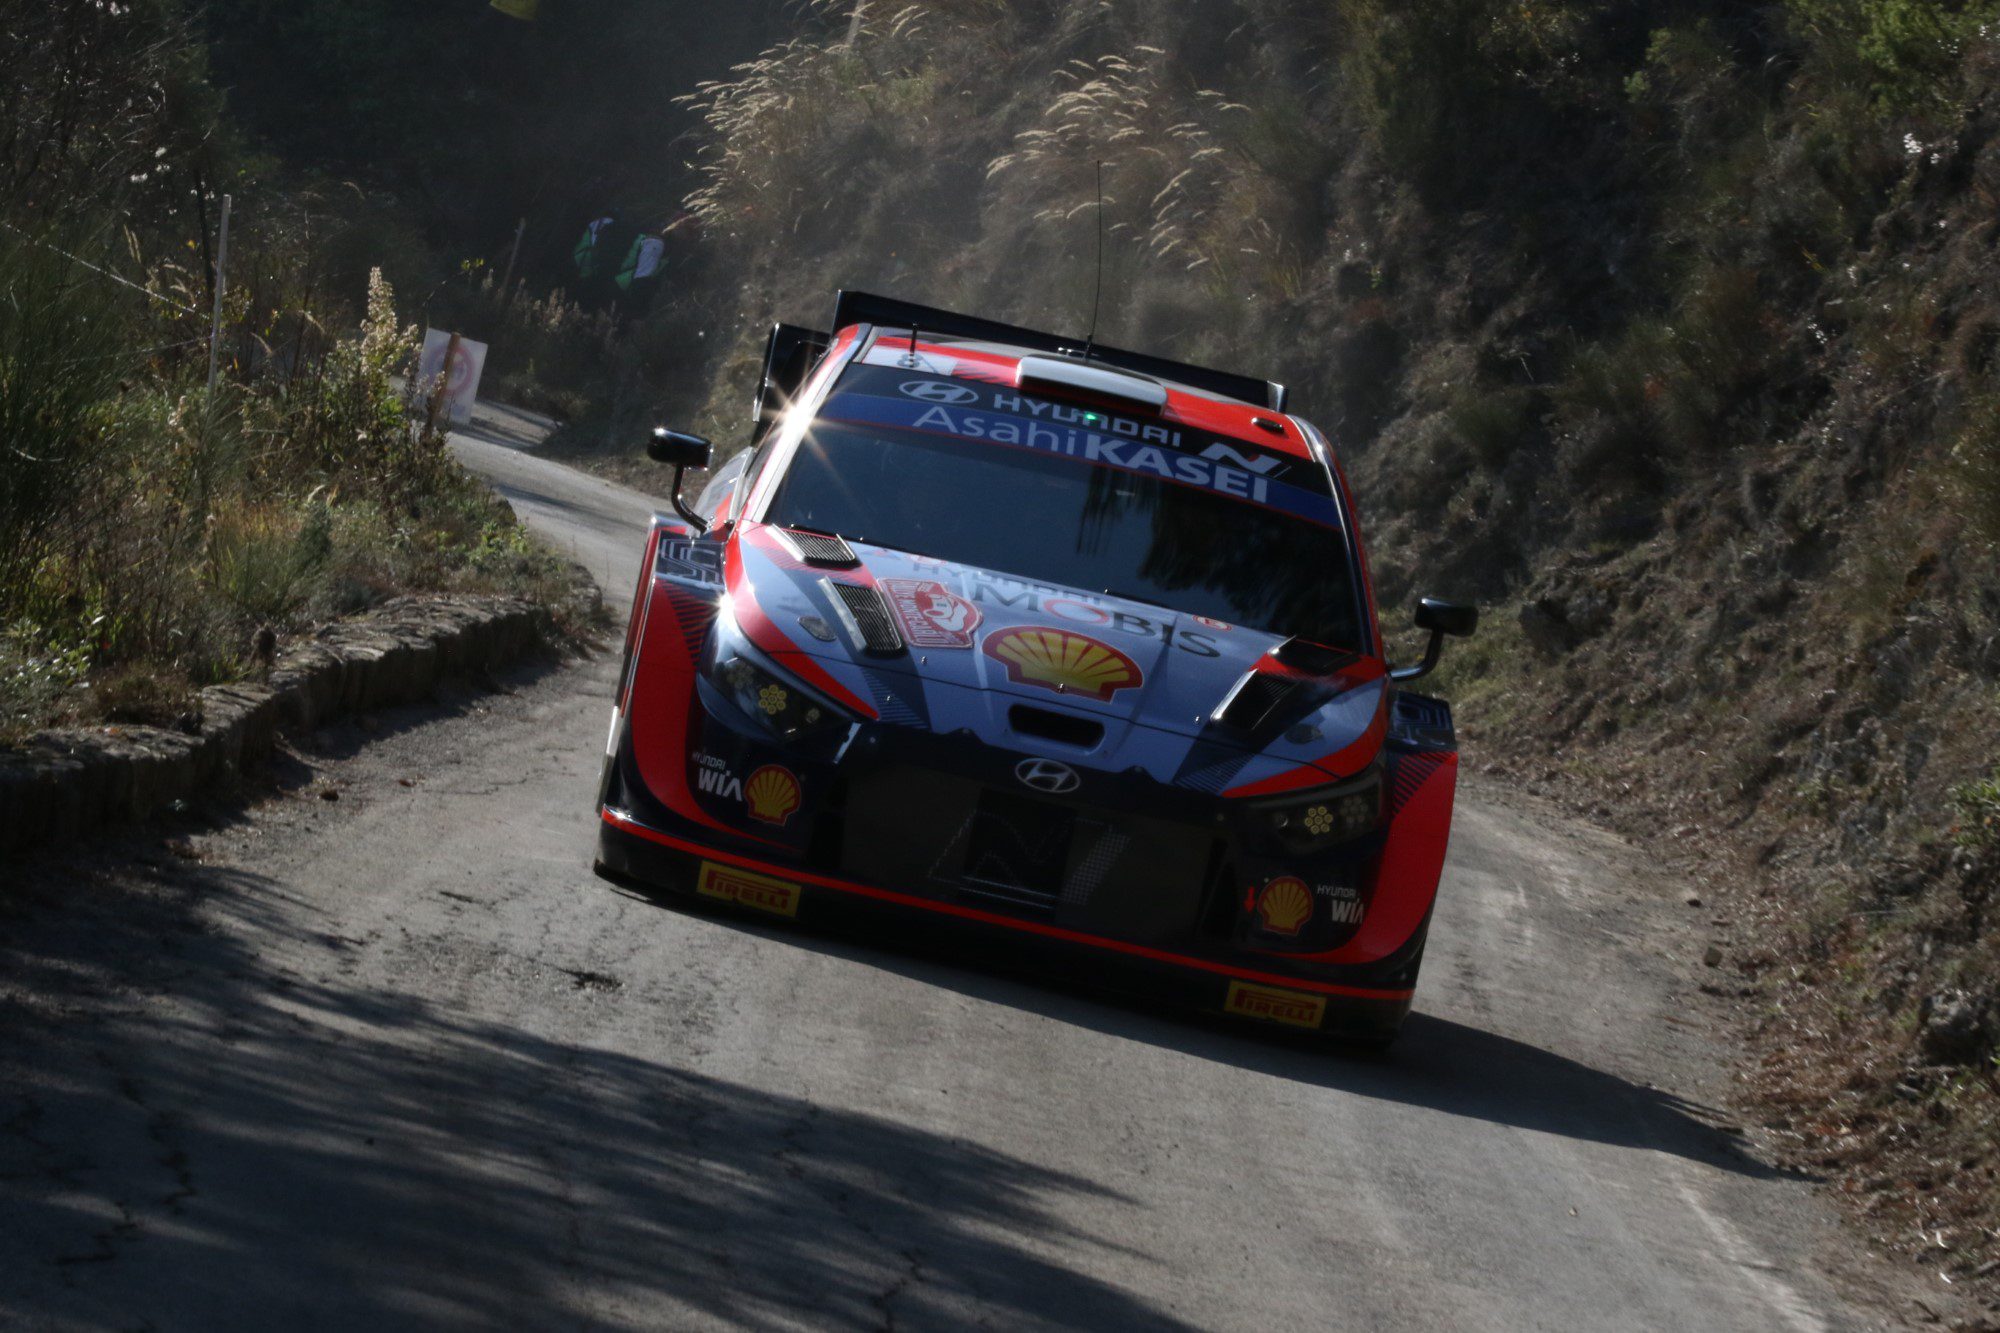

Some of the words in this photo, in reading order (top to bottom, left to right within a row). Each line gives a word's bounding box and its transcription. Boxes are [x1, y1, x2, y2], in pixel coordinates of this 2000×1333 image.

[993, 394, 1181, 448] HYUNDAI
[912, 405, 1268, 504] AsahiKASEI
[971, 582, 1221, 658] MOBIS
[699, 767, 743, 801] WIA
[706, 870, 791, 909] PIRELLI
[1332, 898, 1363, 924] WIA
[1234, 988, 1318, 1022] PIRELLI
